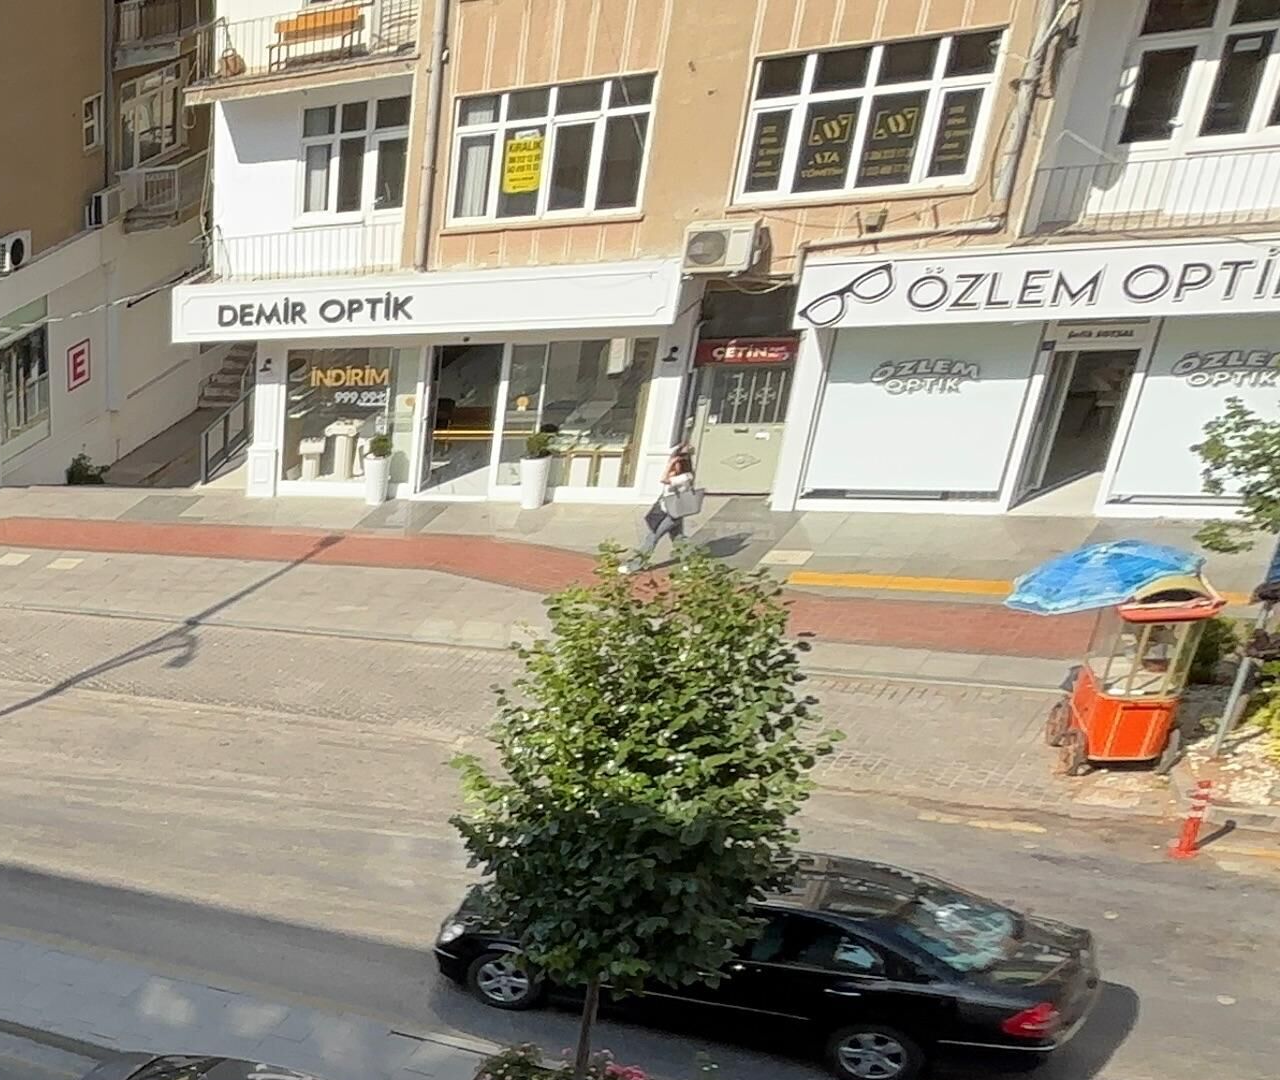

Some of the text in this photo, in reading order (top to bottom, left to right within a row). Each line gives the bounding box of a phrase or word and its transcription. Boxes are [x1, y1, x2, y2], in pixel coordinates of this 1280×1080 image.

[907, 247, 1280, 312] ÖZLEM OPTİ
[217, 291, 414, 328] DEMİR OPTİK
[71, 349, 86, 380] E
[309, 364, 390, 388] İNDİRİM
[871, 358, 980, 383] ÖZLEM
